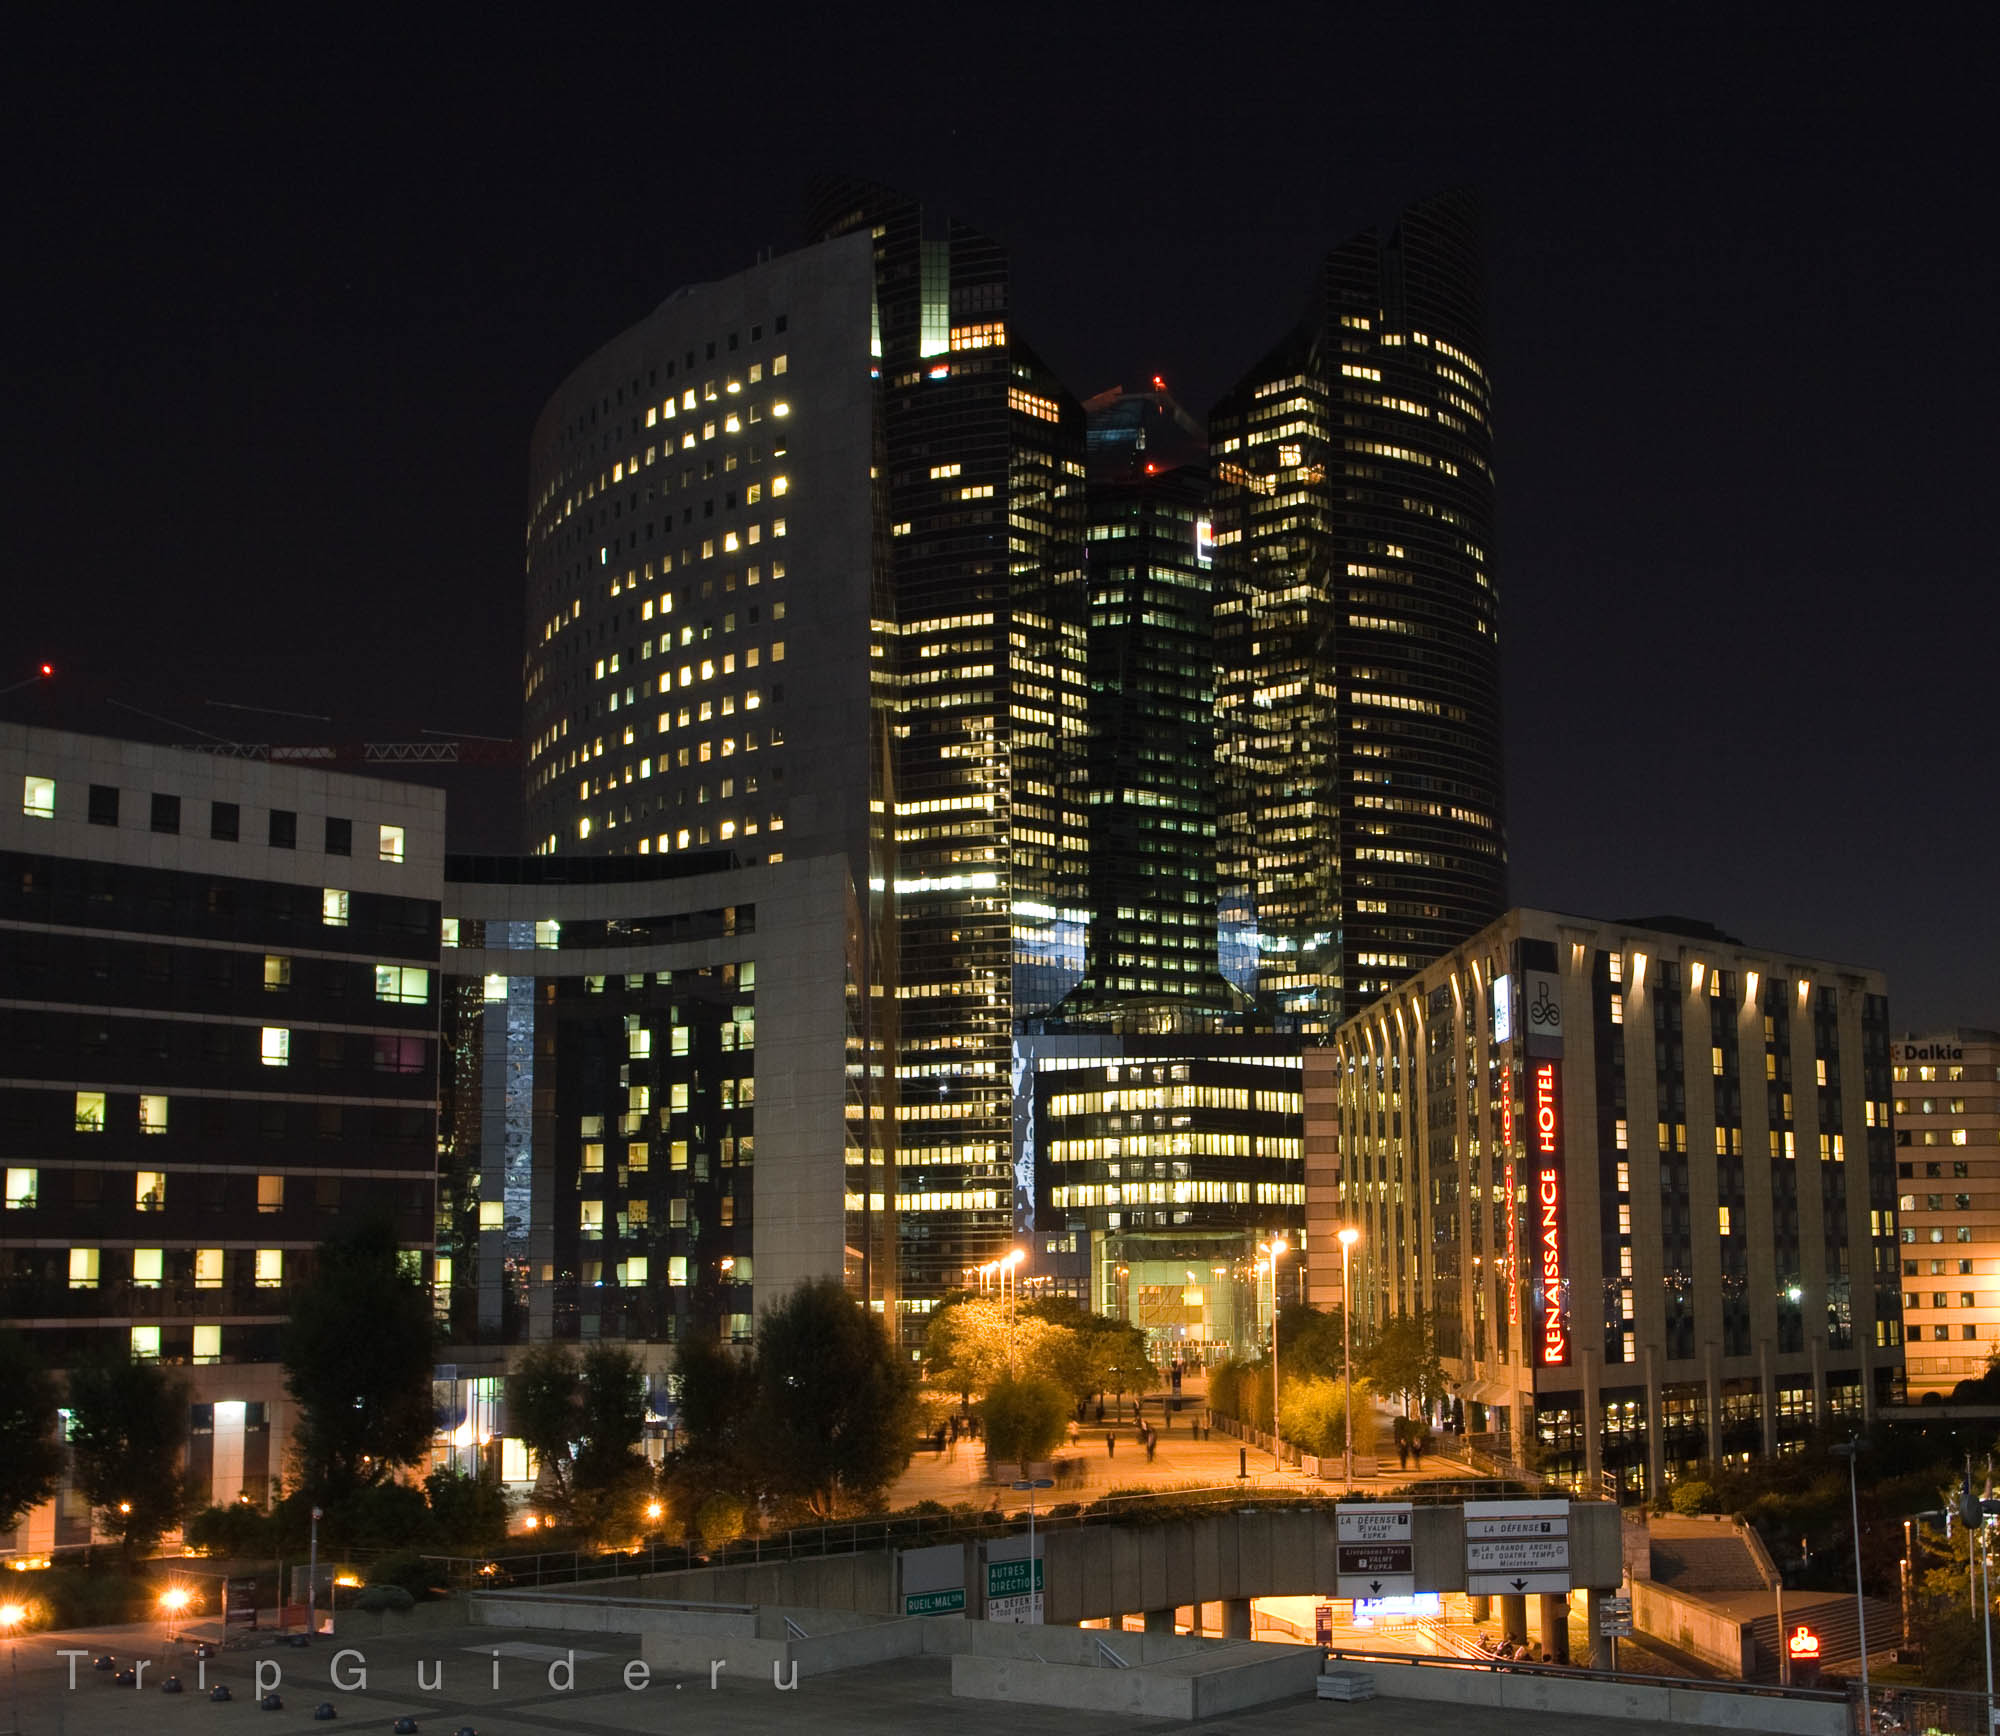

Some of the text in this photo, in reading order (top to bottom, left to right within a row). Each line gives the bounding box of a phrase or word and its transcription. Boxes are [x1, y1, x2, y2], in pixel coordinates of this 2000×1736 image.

[1904, 1044, 1962, 1060] Dalkia
[1502, 1065, 1517, 1325] RENAISSANCE HOTEL
[1537, 1064, 1565, 1363] RENAISSANCE HOTEL
[1340, 1517, 1351, 1525] LA
[1368, 1524, 1393, 1532] VALMY
[1484, 1525, 1494, 1533] LA
[1500, 1522, 1539, 1533] DÉFENSE
[1495, 1544, 1524, 1552] GRANDE
[1529, 1543, 1553, 1551] ARCHE
[1481, 1552, 1494, 1560] LES
[1532, 1550, 1556, 1558] TEMPS
[991, 1565, 1025, 1578] AUTRES
[991, 1576, 1041, 1593] DIRECTIOS
[990, 1601, 999, 1610] LA
